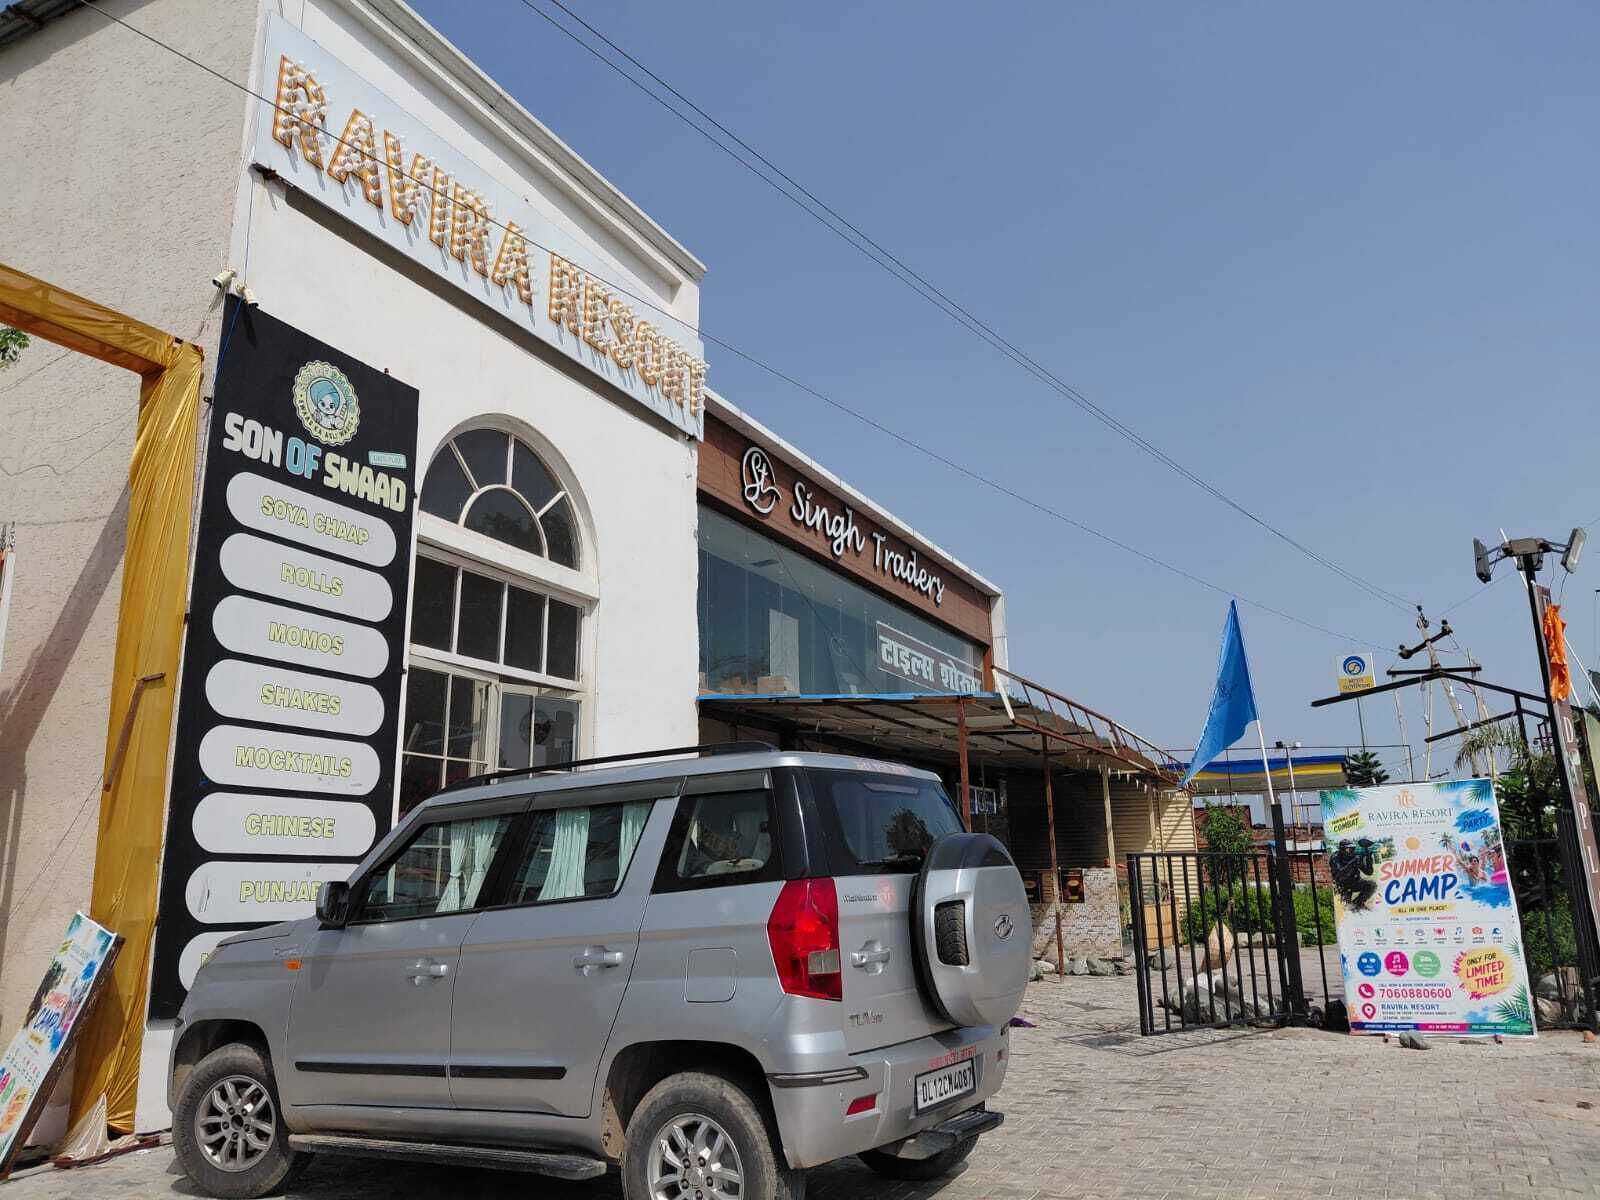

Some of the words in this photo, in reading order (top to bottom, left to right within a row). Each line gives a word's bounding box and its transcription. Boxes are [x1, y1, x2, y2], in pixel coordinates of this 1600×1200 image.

[271, 54, 535, 306] RAVIRA
[548, 252, 709, 417] RESORT
[223, 412, 283, 467] SON
[286, 437, 322, 479] OF
[323, 452, 407, 513] SWAAD
[260, 495, 310, 528] SOYA
[313, 513, 370, 546] CHAAP
[791, 481, 866, 557] Singh
[280, 562, 344, 597] ROLLS
[268, 621, 345, 656] MOMOS
[879, 634, 935, 682] टाइल्स
[261, 683, 342, 716] SHAKES
[235, 746, 353, 778] MOCKTAILS
[245, 813, 337, 838] CHINESE
[1333, 817, 1360, 833] COMBAT
[1367, 810, 1409, 822] RAVIRA
[1412, 807, 1454, 818] RESORT
[1463, 814, 1489, 831] PARTY
[1379, 854, 1455, 881] SUMMER
[1384, 873, 1458, 905] CAMP
[1466, 955, 1483, 967] ONLY
[1484, 952, 1497, 962] FOR
[1466, 960, 1505, 979] LIMITED
[1379, 988, 1452, 999] 7060880600
[1474, 972, 1504, 990] TIME!
